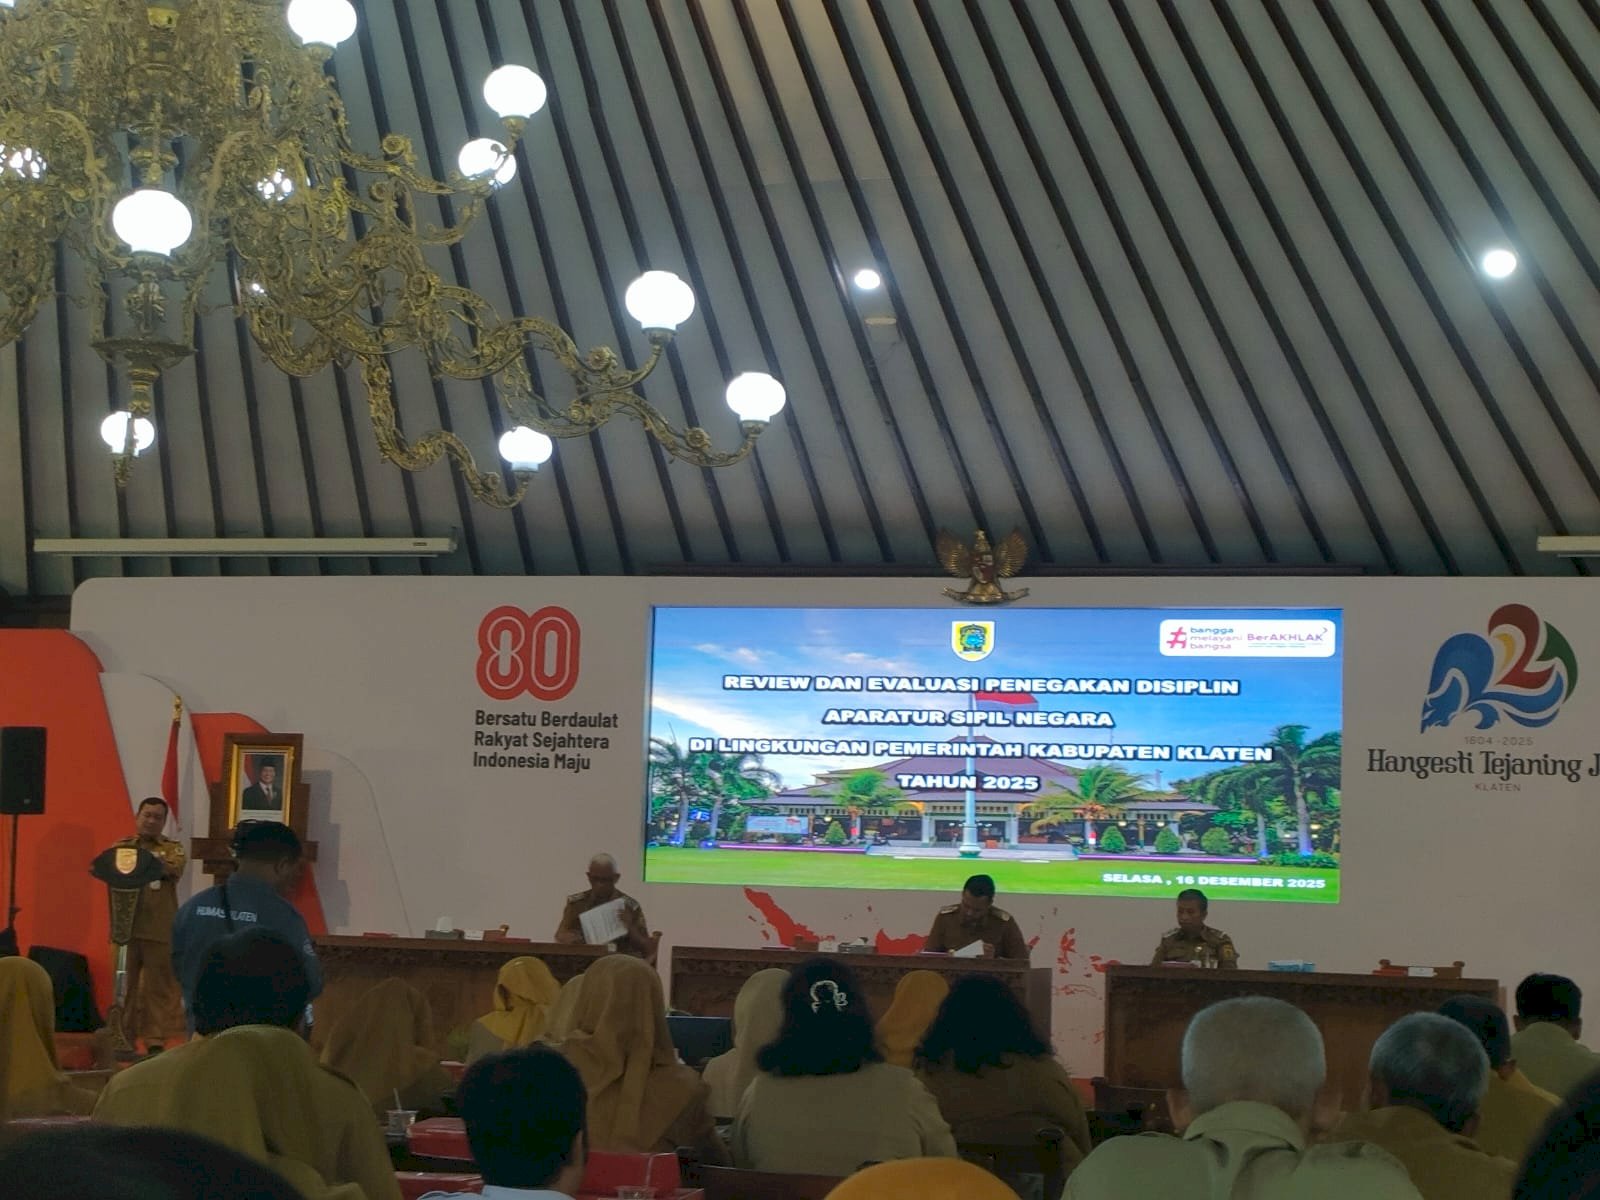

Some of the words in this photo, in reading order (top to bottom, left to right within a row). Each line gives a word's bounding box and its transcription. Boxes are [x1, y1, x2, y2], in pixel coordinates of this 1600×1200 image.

[1190, 627, 1234, 635] bangga
[1190, 635, 1243, 643] melayani
[1247, 633, 1324, 642] BerAKHLAK
[476, 605, 581, 701] 80
[1190, 642, 1232, 651] bangsa
[724, 675, 810, 690] REVIEW
[815, 676, 861, 690] DAN
[867, 677, 979, 691] EVALUASI
[986, 678, 1130, 692] PENEGAKAN
[1136, 680, 1239, 694] DISIPLIN
[475, 710, 536, 726] Bersatu
[541, 711, 618, 728] Berdaulat
[824, 709, 945, 724] APARATUR
[951, 710, 1009, 725] SIPIL
[1016, 711, 1114, 726] NEGARA
[474, 731, 528, 750] Rakyat
[532, 732, 610, 751] Sejahtera
[690, 737, 712, 752] DI
[718, 738, 868, 754] LINGKUNGAN
[874, 741, 1022, 757] PEMERINTAH
[1029, 744, 1171, 759] KABUPATEN
[1177, 746, 1273, 761] KLATEN
[473, 752, 550, 769] Indonesia
[554, 754, 591, 773] Maju
[1367, 749, 1474, 780] Hangesti
[1480, 751, 1582, 782] Tejaning
[897, 774, 976, 788] TAHUN
[982, 776, 1039, 790] 2025
[1474, 783, 1521, 793] KLATEN
[1103, 873, 1162, 884] SELASA
[1176, 875, 1194, 885] 16
[1198, 876, 1284, 887] DESEMBER
[1287, 878, 1326, 889] 2025
